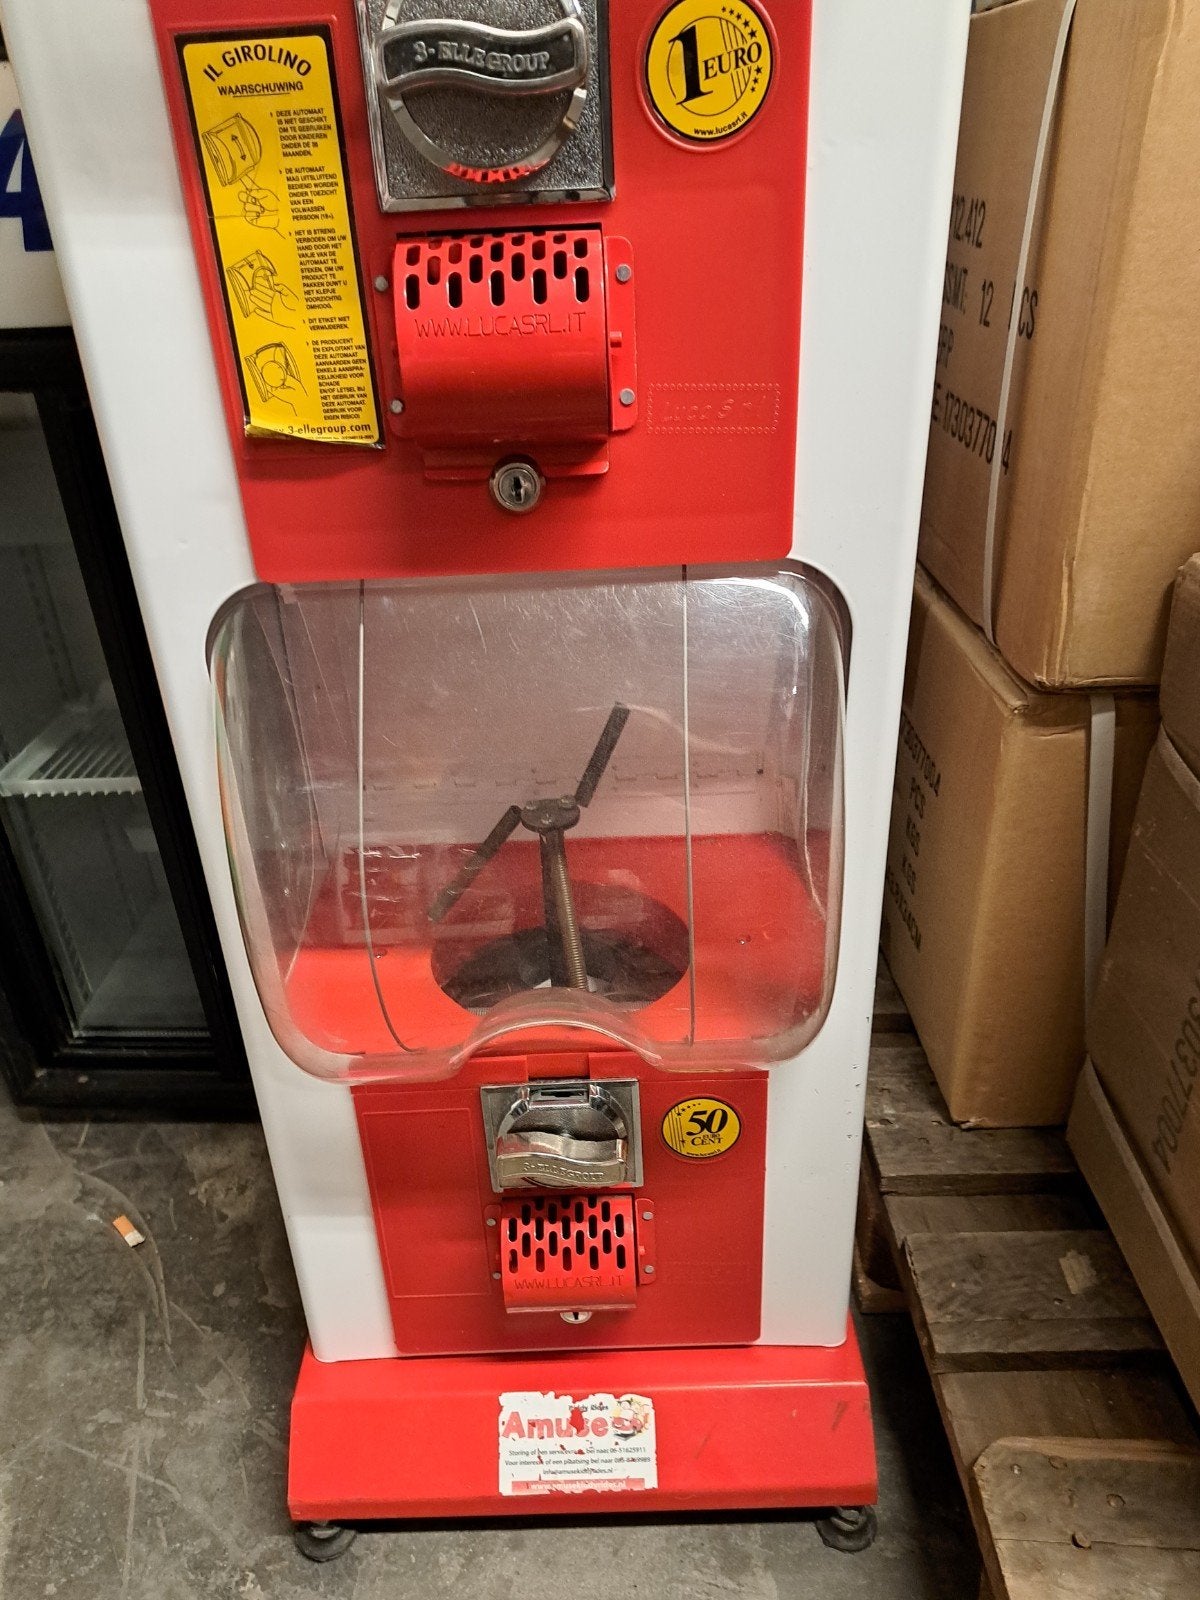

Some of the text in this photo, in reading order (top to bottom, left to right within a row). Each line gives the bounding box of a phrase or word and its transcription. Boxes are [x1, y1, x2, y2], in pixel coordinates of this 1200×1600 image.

[203, 44, 312, 82] IL GIROLINO
[413, 40, 550, 72] 3-ELLEGROUP
[668, 24, 762, 105] 1 EURO
[217, 81, 303, 96] WAARSCHUWING
[276, 107, 324, 117] DEZE AUTOMAAT
[298, 116, 327, 124] GESCHIKT
[694, 111, 748, 136] www.lucasrl.it
[294, 166, 325, 174] AUTOMAAT
[291, 206, 325, 214] VOLWASSEN
[296, 236, 326, 244] VERBODEN
[980, 279, 994, 328] 12
[414, 312, 586, 338] WWW.LUCASRL.IT
[943, 390, 1012, 475] 173037704
[686, 1108, 728, 1136] 50
[515, 1275, 624, 1290] WWW.LUCASRL.IT
